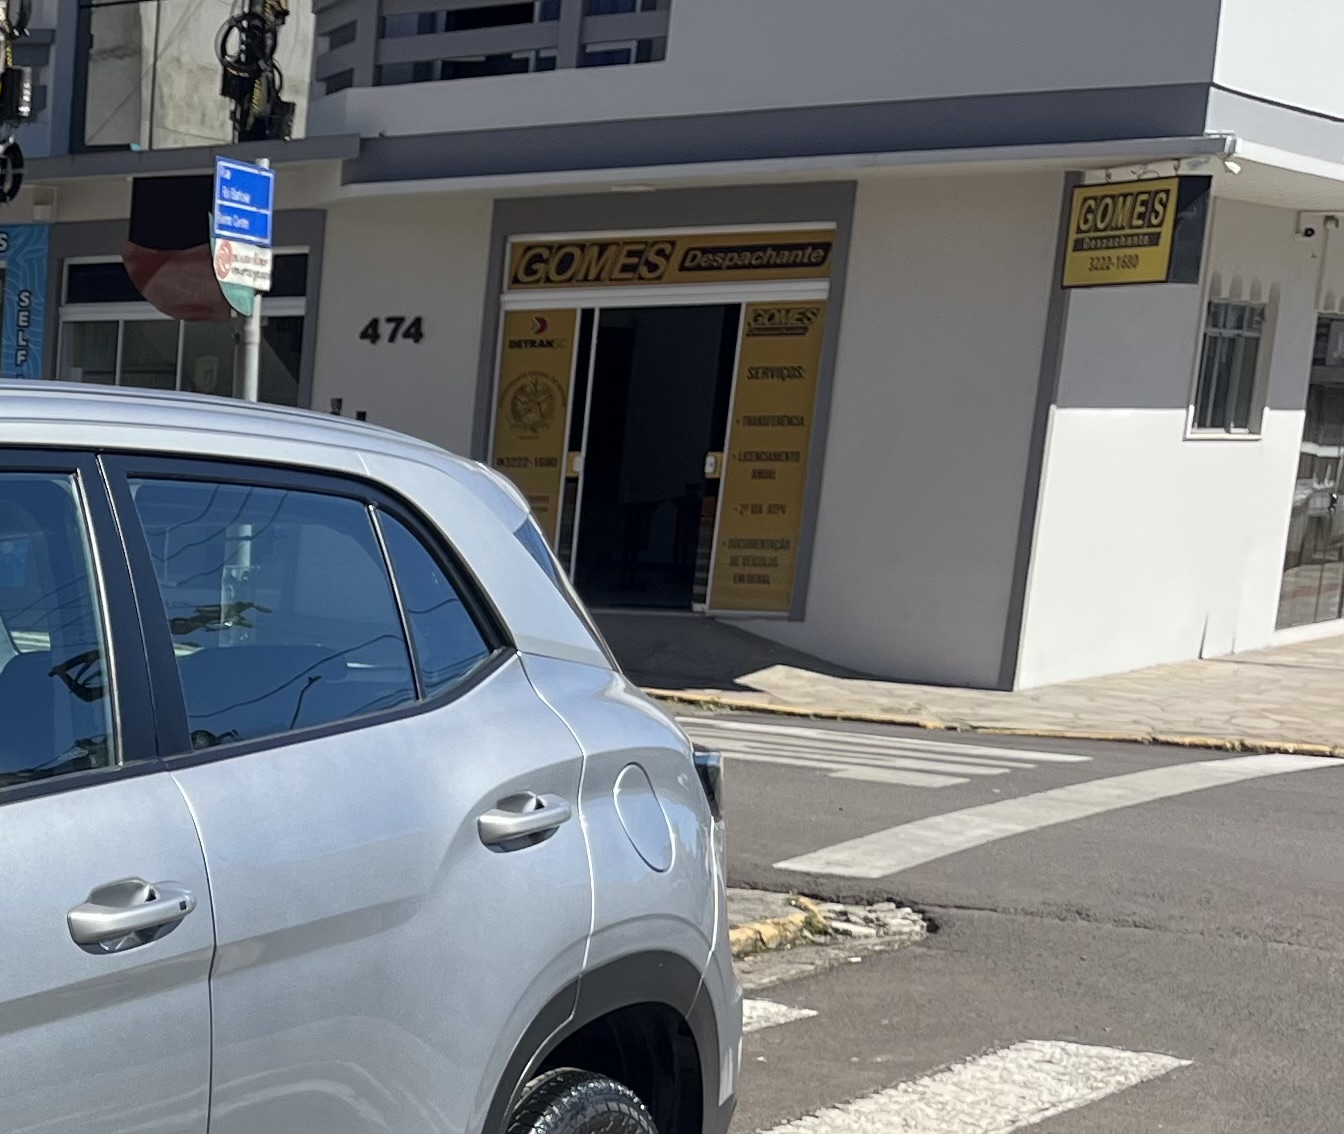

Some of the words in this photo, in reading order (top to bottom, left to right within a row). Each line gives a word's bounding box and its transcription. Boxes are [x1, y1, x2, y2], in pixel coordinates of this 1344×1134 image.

[1079, 190, 1167, 231] GOMES
[516, 241, 674, 283] GOMES
[684, 246, 825, 270] Despachante
[359, 315, 424, 344] 474
[752, 307, 820, 326] GOMES
